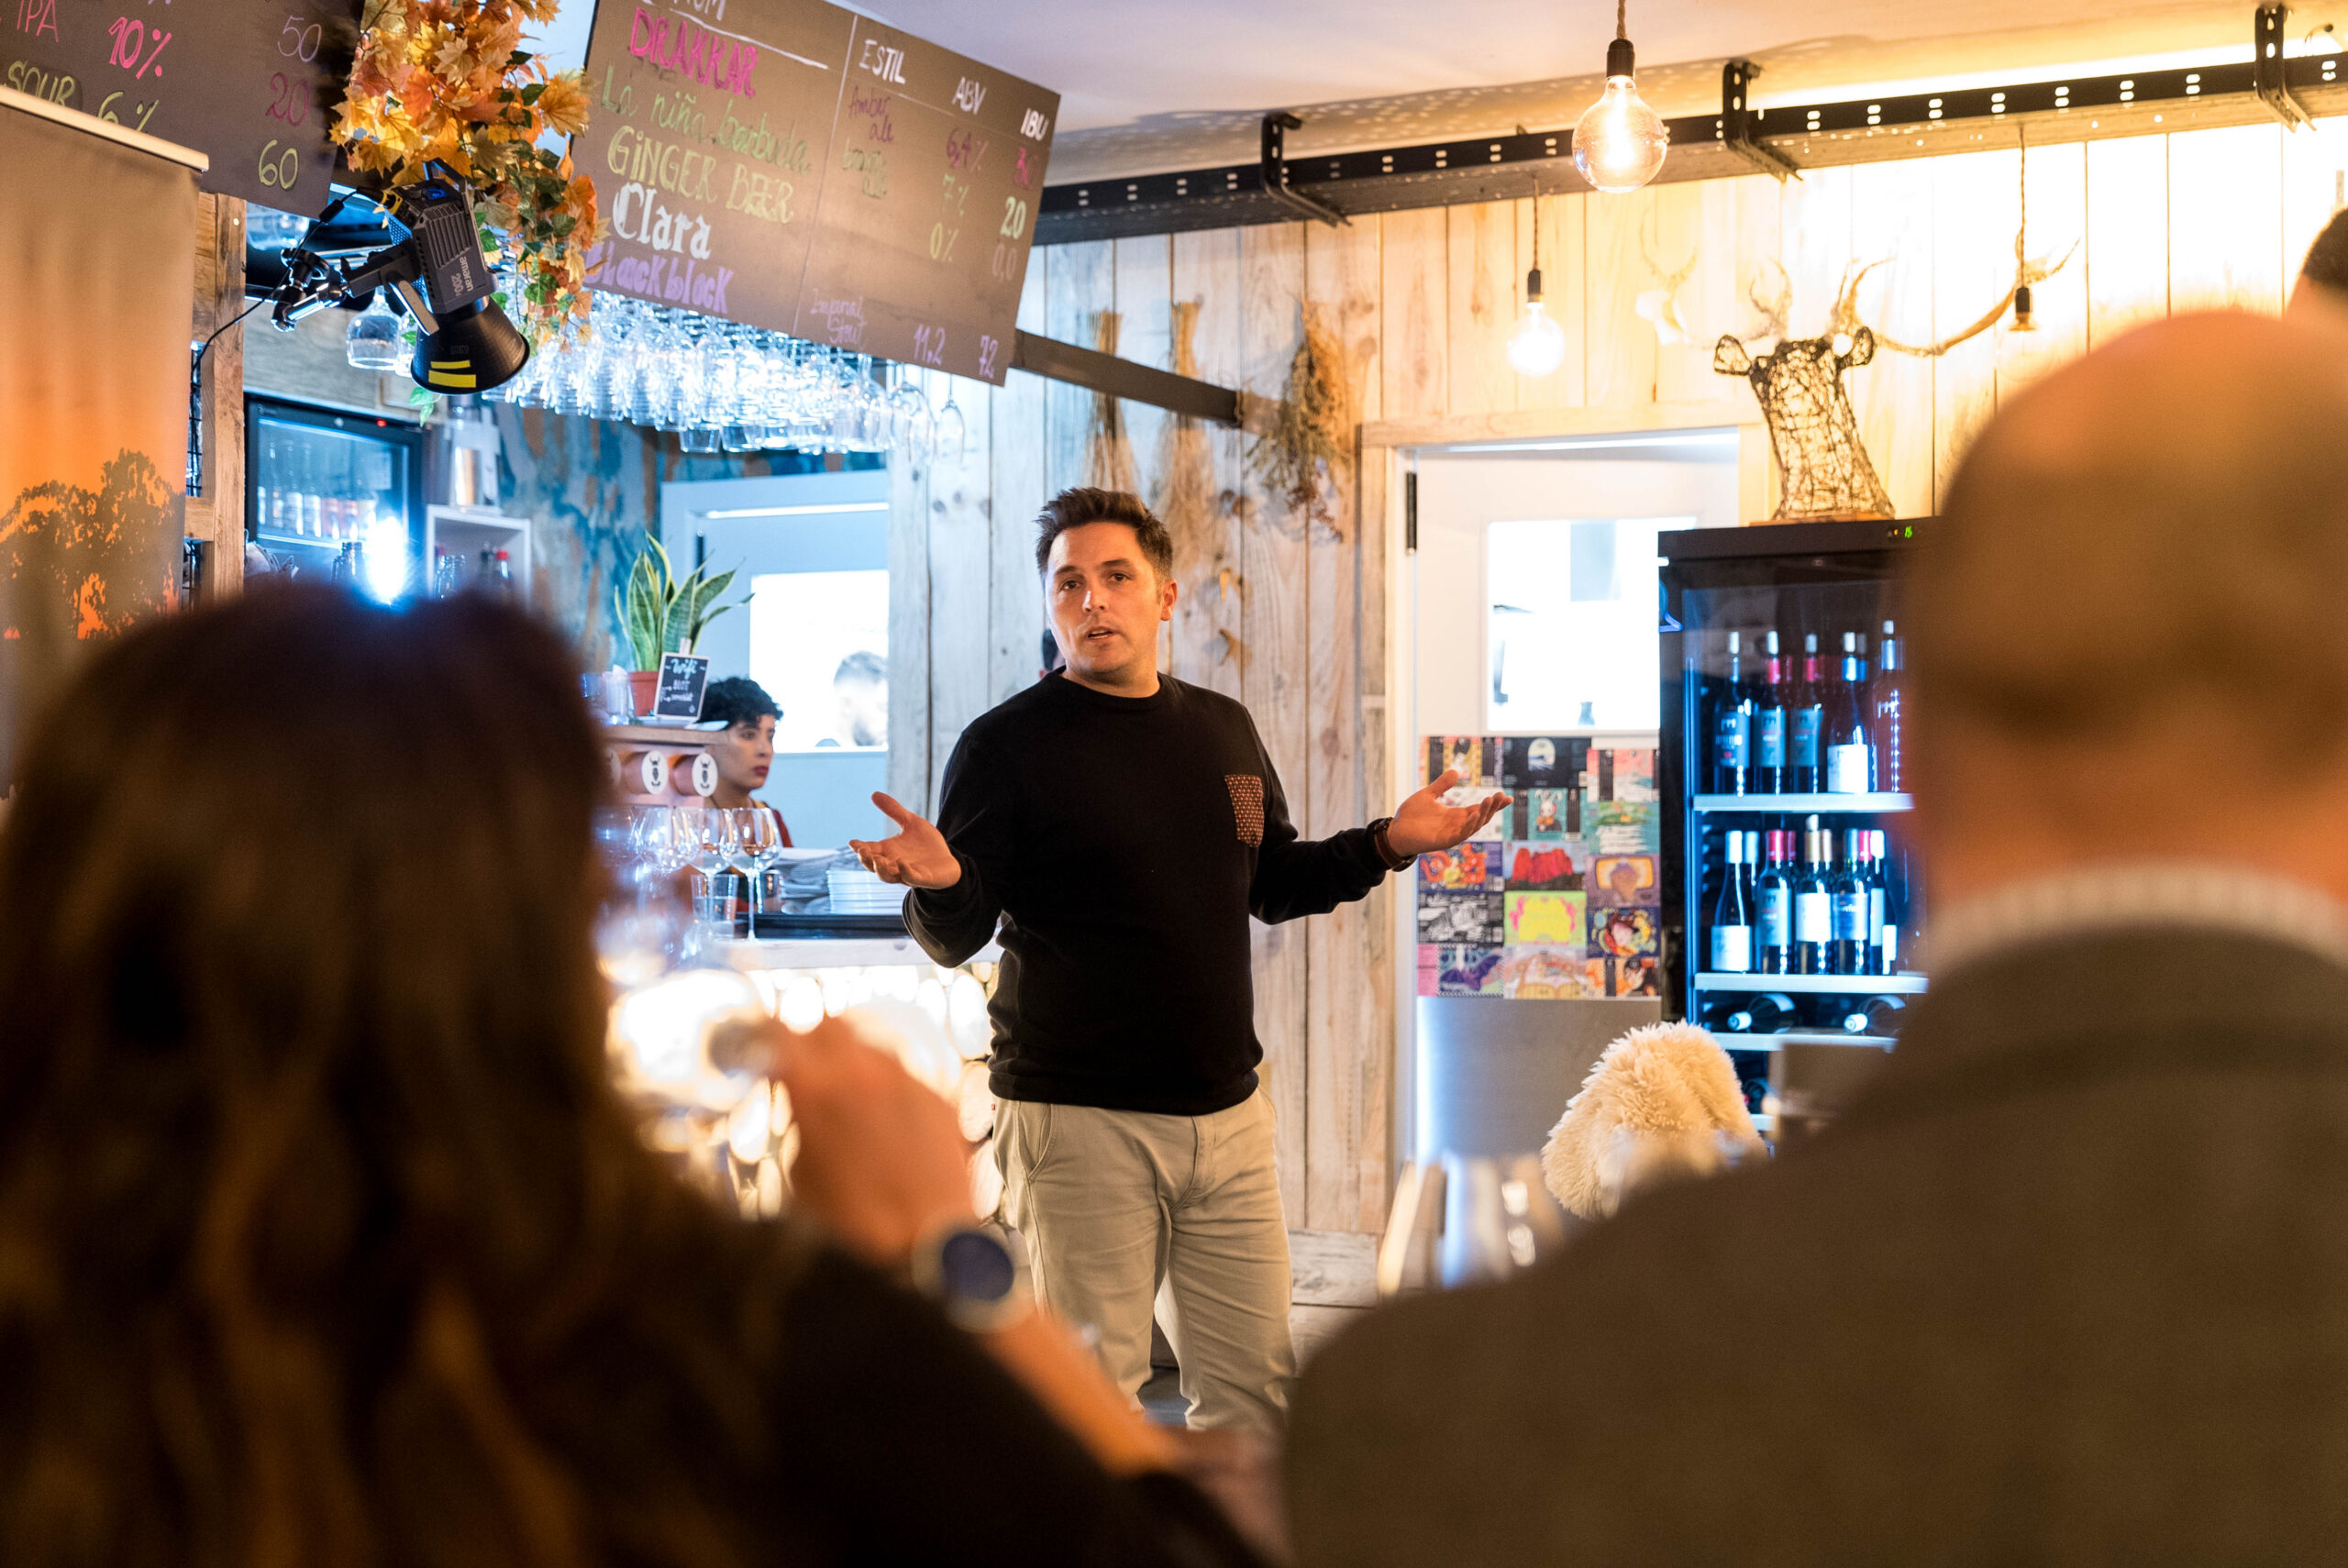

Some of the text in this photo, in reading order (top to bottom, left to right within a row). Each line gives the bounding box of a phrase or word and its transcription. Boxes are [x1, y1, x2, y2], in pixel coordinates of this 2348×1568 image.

[108, 17, 172, 80] 10%
[277, 15, 322, 62] 50
[629, 7, 758, 98] DRAKKAR
[858, 39, 905, 84] ESTIL
[8, 61, 75, 107] SOUR
[267, 72, 309, 126] 20
[601, 64, 638, 117] La
[649, 91, 704, 144] niña
[952, 76, 987, 116] ABV
[1020, 107, 1049, 141] IBU
[258, 139, 299, 191] 60
[725, 162, 794, 224] BEER
[613, 182, 712, 260] Clara
[1000, 195, 1027, 240] 20
[929, 222, 959, 263] 0%
[460, 256, 473, 292] amaran
[914, 324, 947, 365] 11,2
[979, 335, 999, 379] 72
